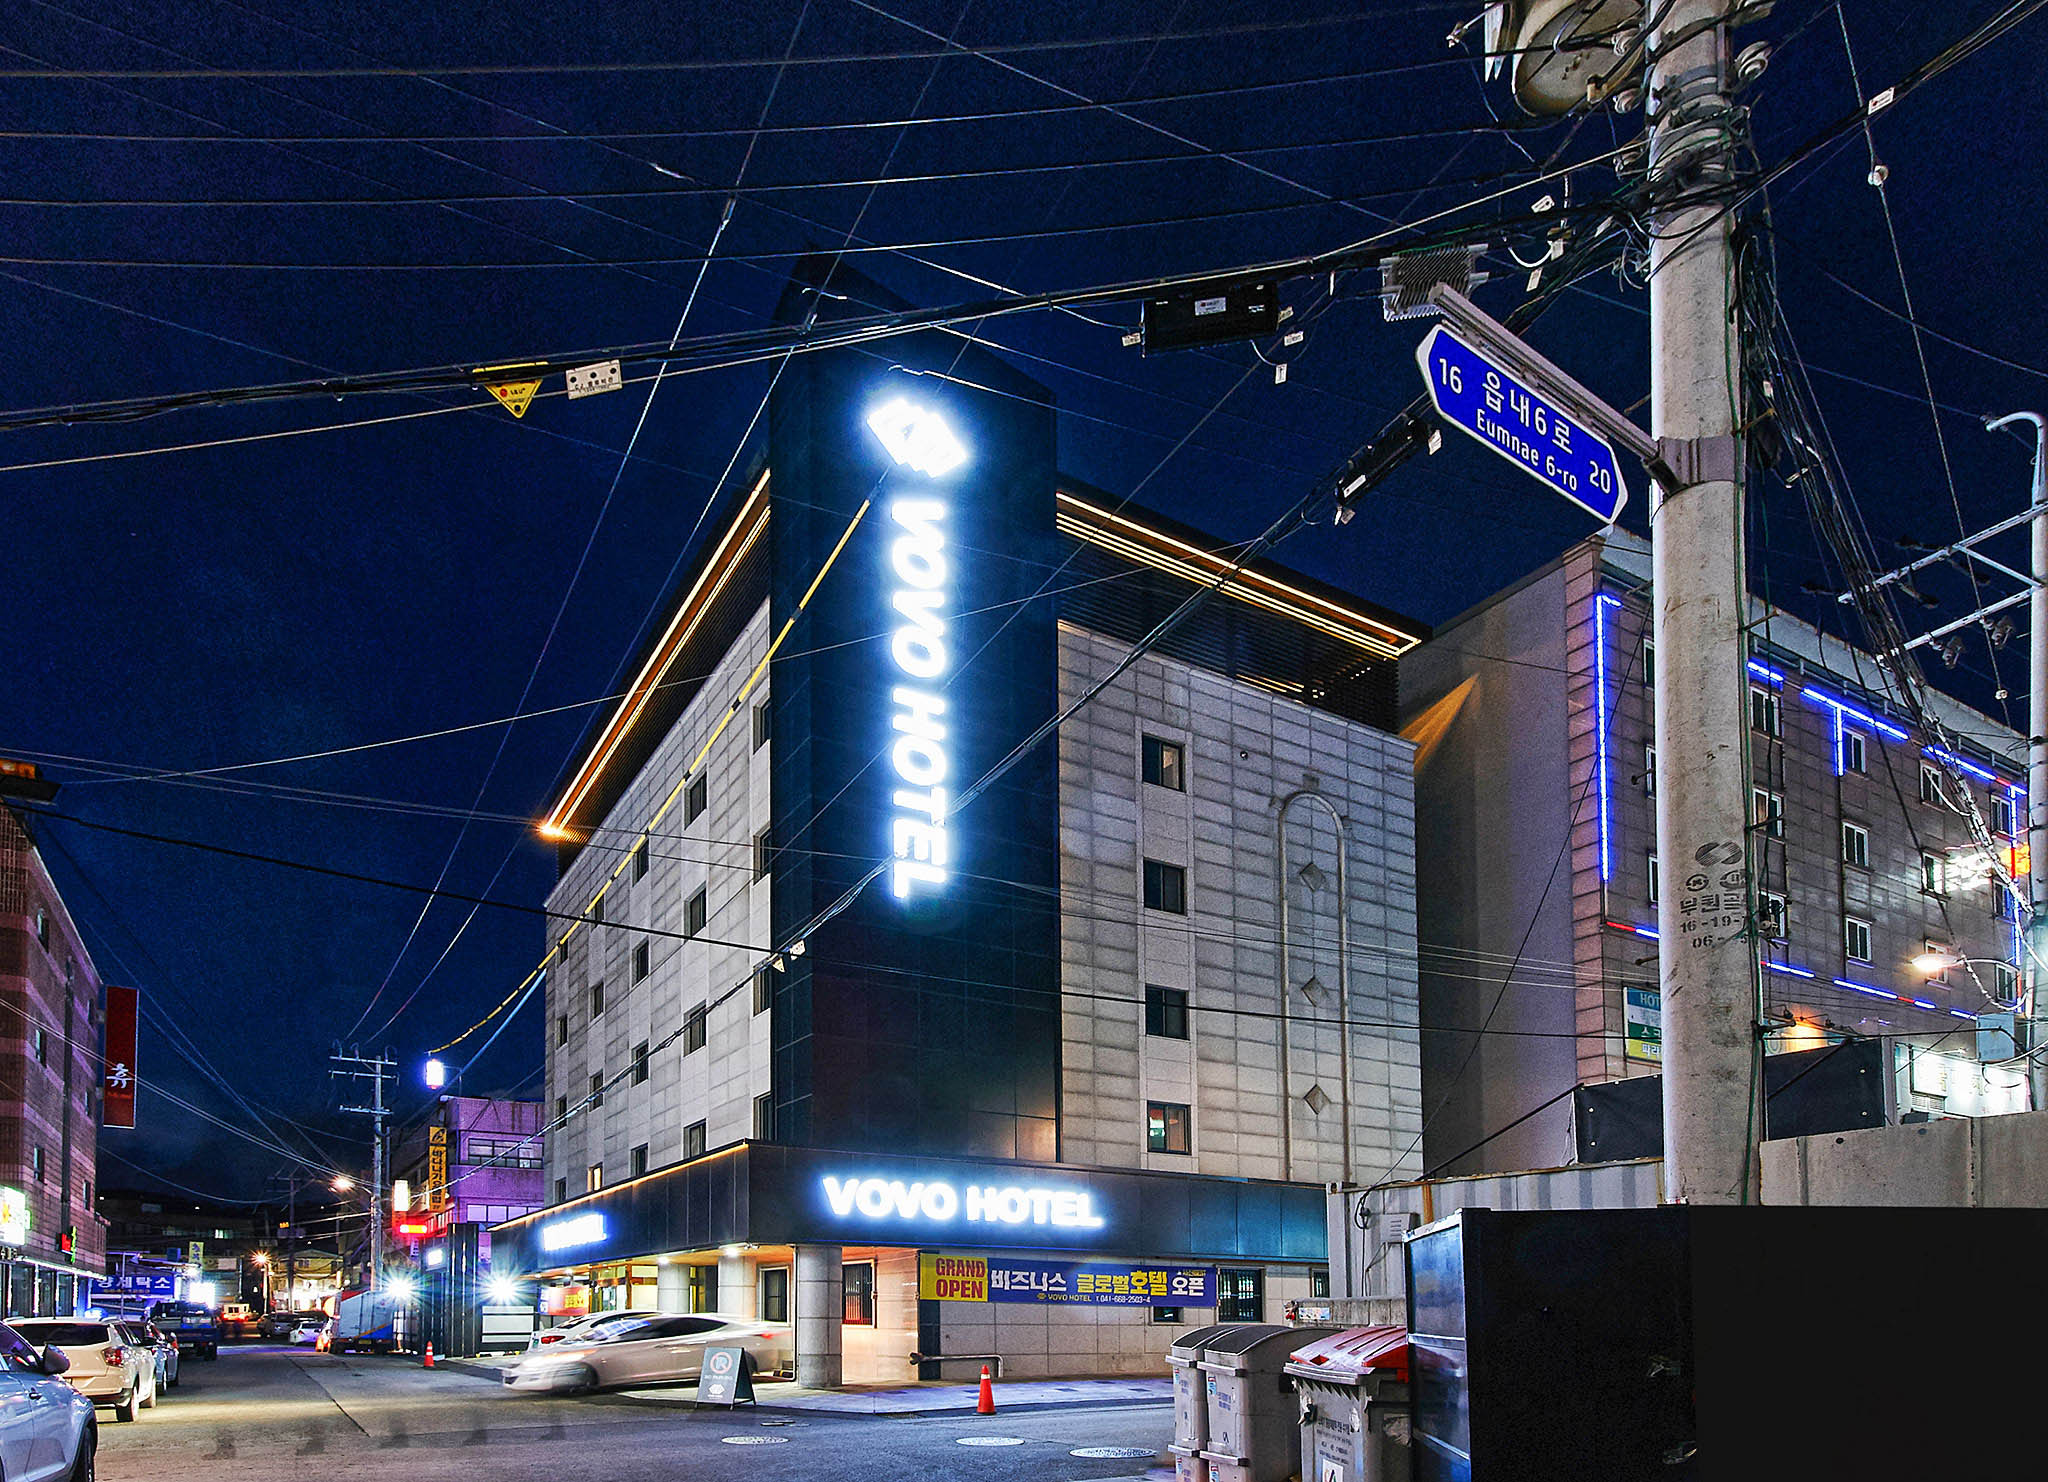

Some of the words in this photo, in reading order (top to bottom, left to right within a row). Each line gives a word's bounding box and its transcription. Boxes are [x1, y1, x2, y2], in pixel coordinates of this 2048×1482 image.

[1439, 358, 1462, 394] 16
[1482, 371, 1573, 455] 읍내6로
[1477, 408, 1539, 466] Eumnae
[1546, 456, 1578, 491] 6-ro
[1589, 460, 1611, 494] 20
[891, 502, 946, 678] VOVO
[891, 687, 946, 899] HOTEL
[822, 1176, 957, 1220] VOVO
[966, 1185, 1104, 1228] HOTEL
[935, 1257, 986, 1278] GRAND
[990, 1269, 1067, 1291] 비즈니스
[1171, 1275, 1205, 1296] 오픈
[935, 1279, 983, 1299] OPEN
[1047, 1293, 1068, 1302] VOVO
[1069, 1294, 1092, 1302] HOTEL
